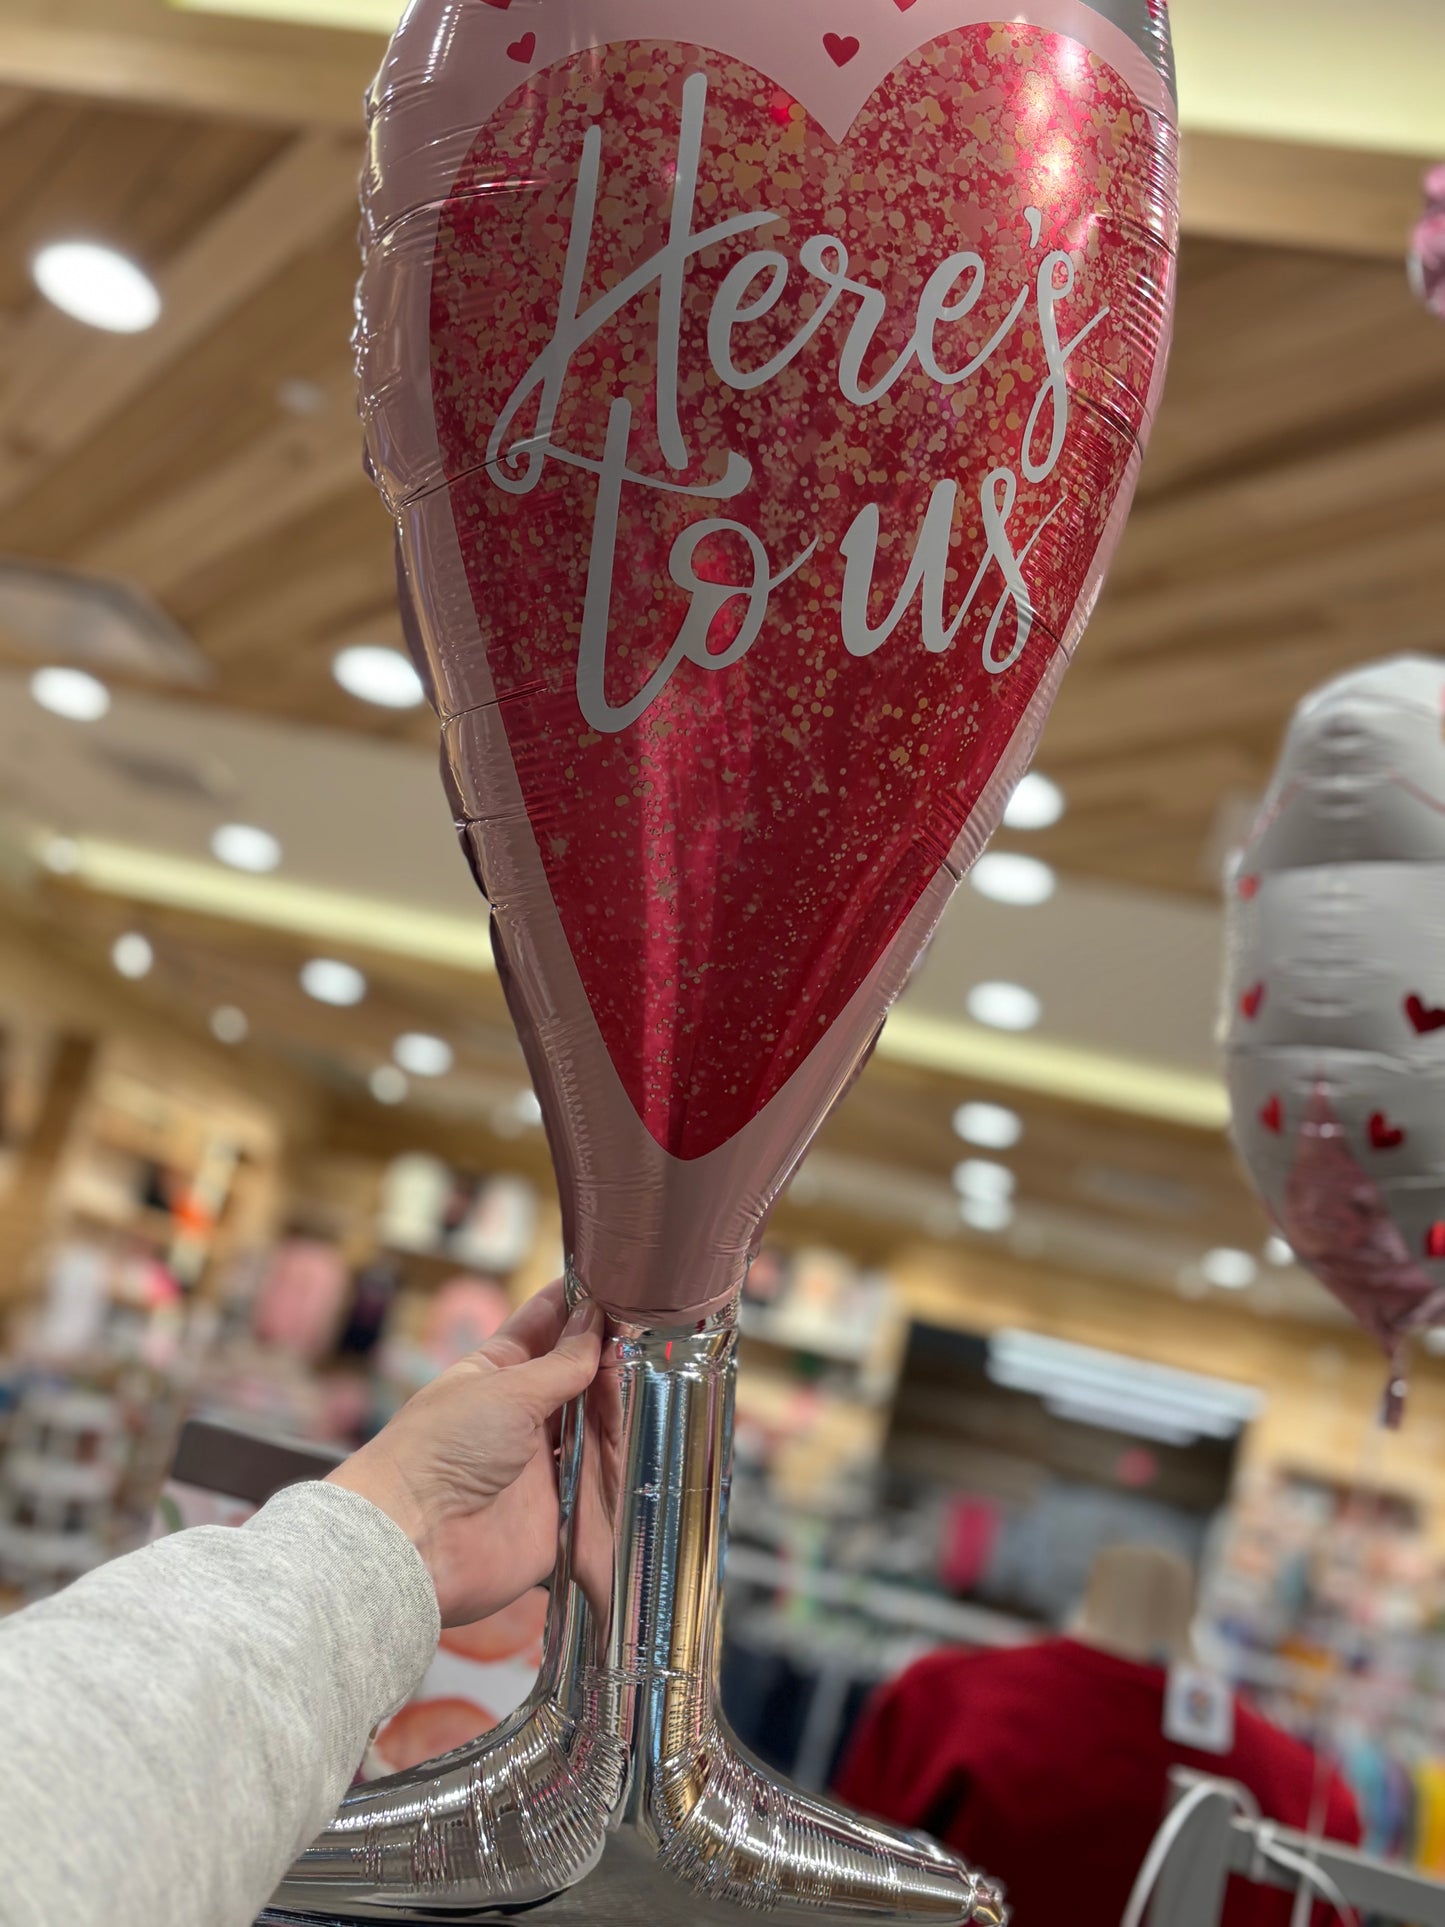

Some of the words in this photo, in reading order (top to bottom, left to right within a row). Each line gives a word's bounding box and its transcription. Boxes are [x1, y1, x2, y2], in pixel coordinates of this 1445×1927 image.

[486, 72, 1110, 494] Here's
[508, 397, 819, 733] to
[840, 466, 1067, 674] us
